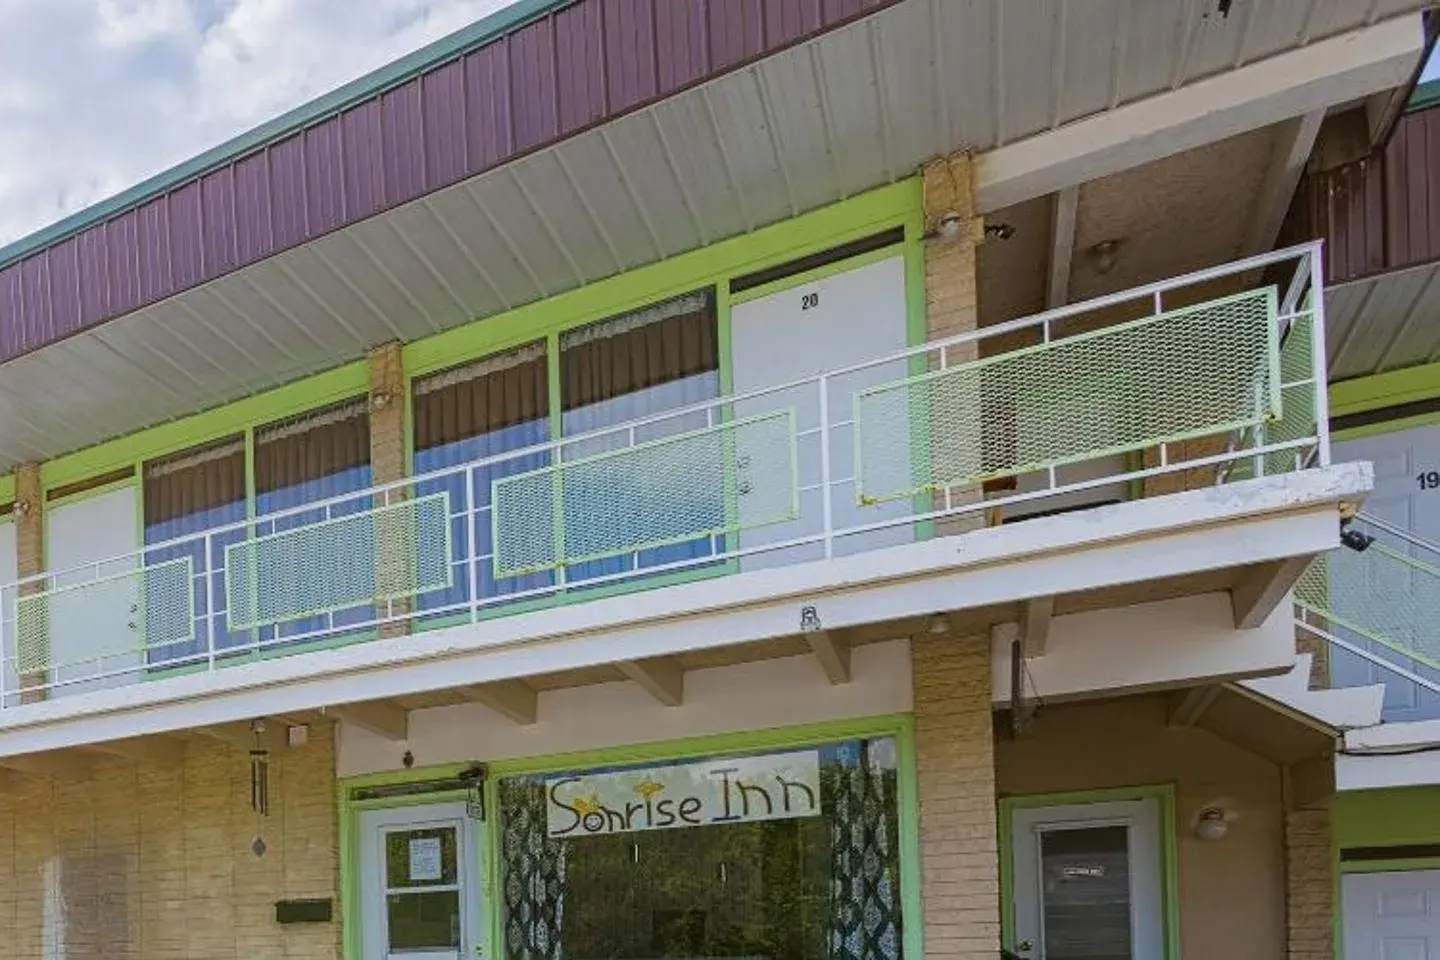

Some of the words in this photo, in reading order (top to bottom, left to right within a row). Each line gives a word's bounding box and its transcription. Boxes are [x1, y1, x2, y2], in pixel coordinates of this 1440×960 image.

[801, 292, 819, 310] 20
[1415, 471, 1440, 490] 19
[550, 777, 701, 835] Sonrise
[710, 767, 815, 821] Inn
